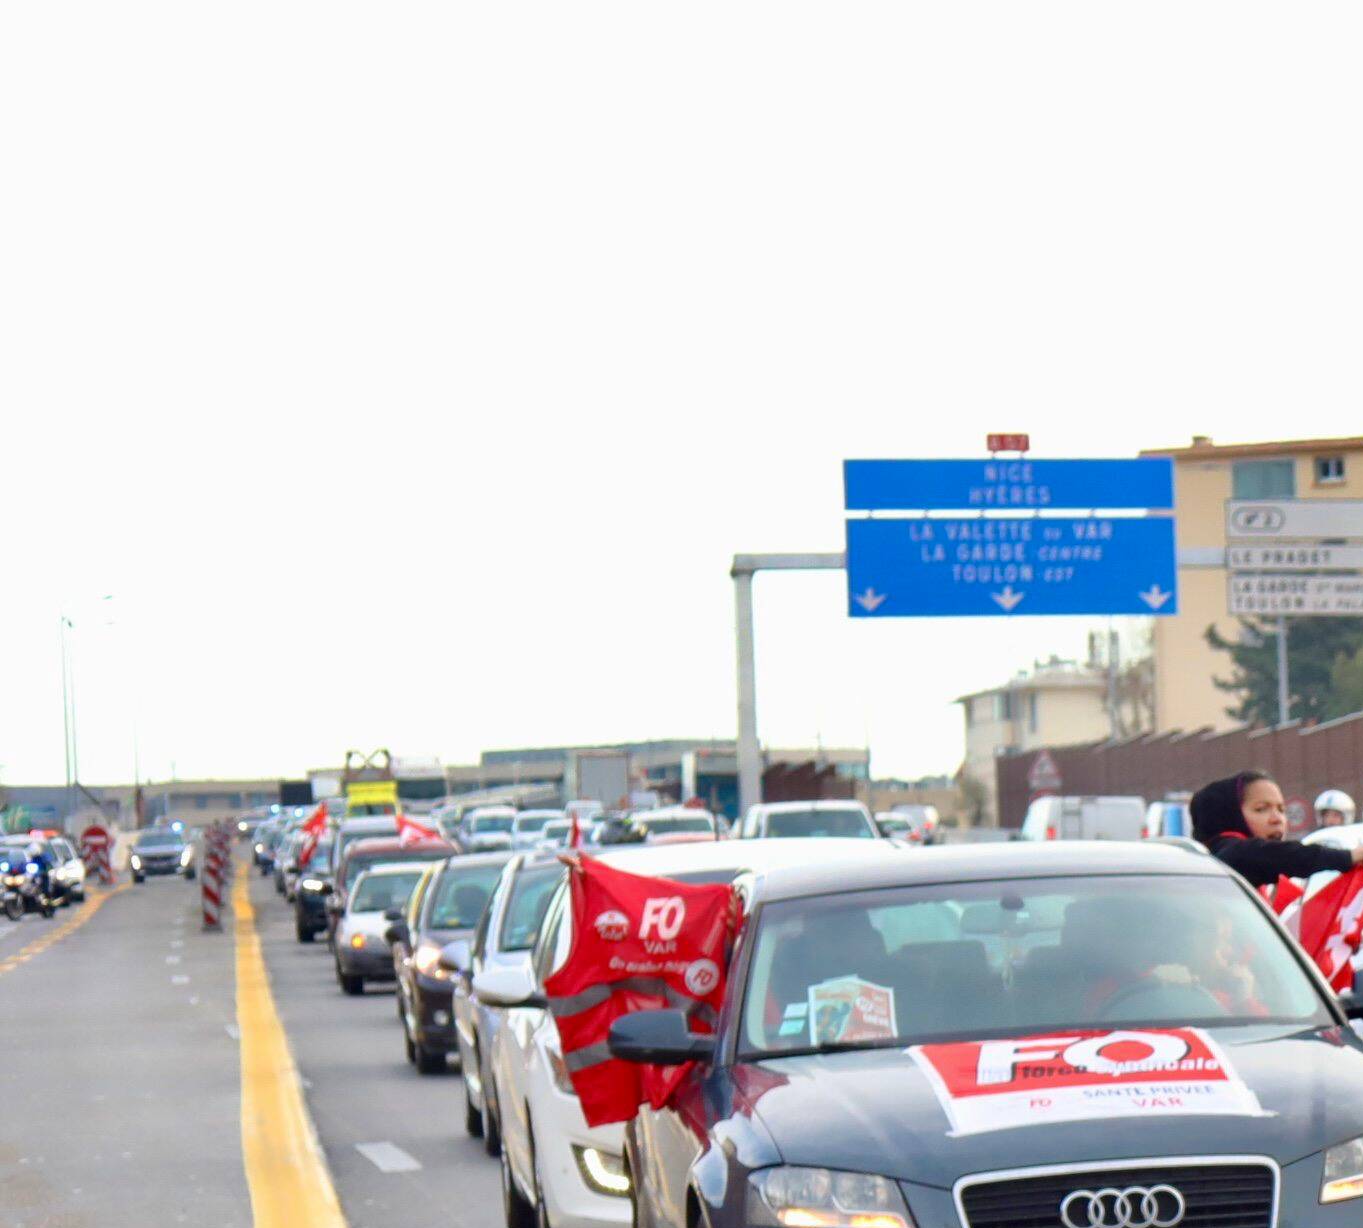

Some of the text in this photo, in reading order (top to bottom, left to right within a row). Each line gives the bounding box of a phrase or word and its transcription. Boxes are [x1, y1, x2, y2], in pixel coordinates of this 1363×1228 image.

[984, 463, 1033, 483] NICE
[909, 521, 935, 541] LA
[944, 521, 1033, 541] VALETTE
[1072, 520, 1114, 540] VAR
[920, 544, 946, 562] LA
[956, 543, 1026, 562] GARDE
[952, 564, 1034, 583] TOULON
[638, 895, 686, 941] FO
[643, 940, 678, 954] VAR
[976, 1030, 1192, 1087] FO
[1131, 1097, 1184, 1108] VAR
